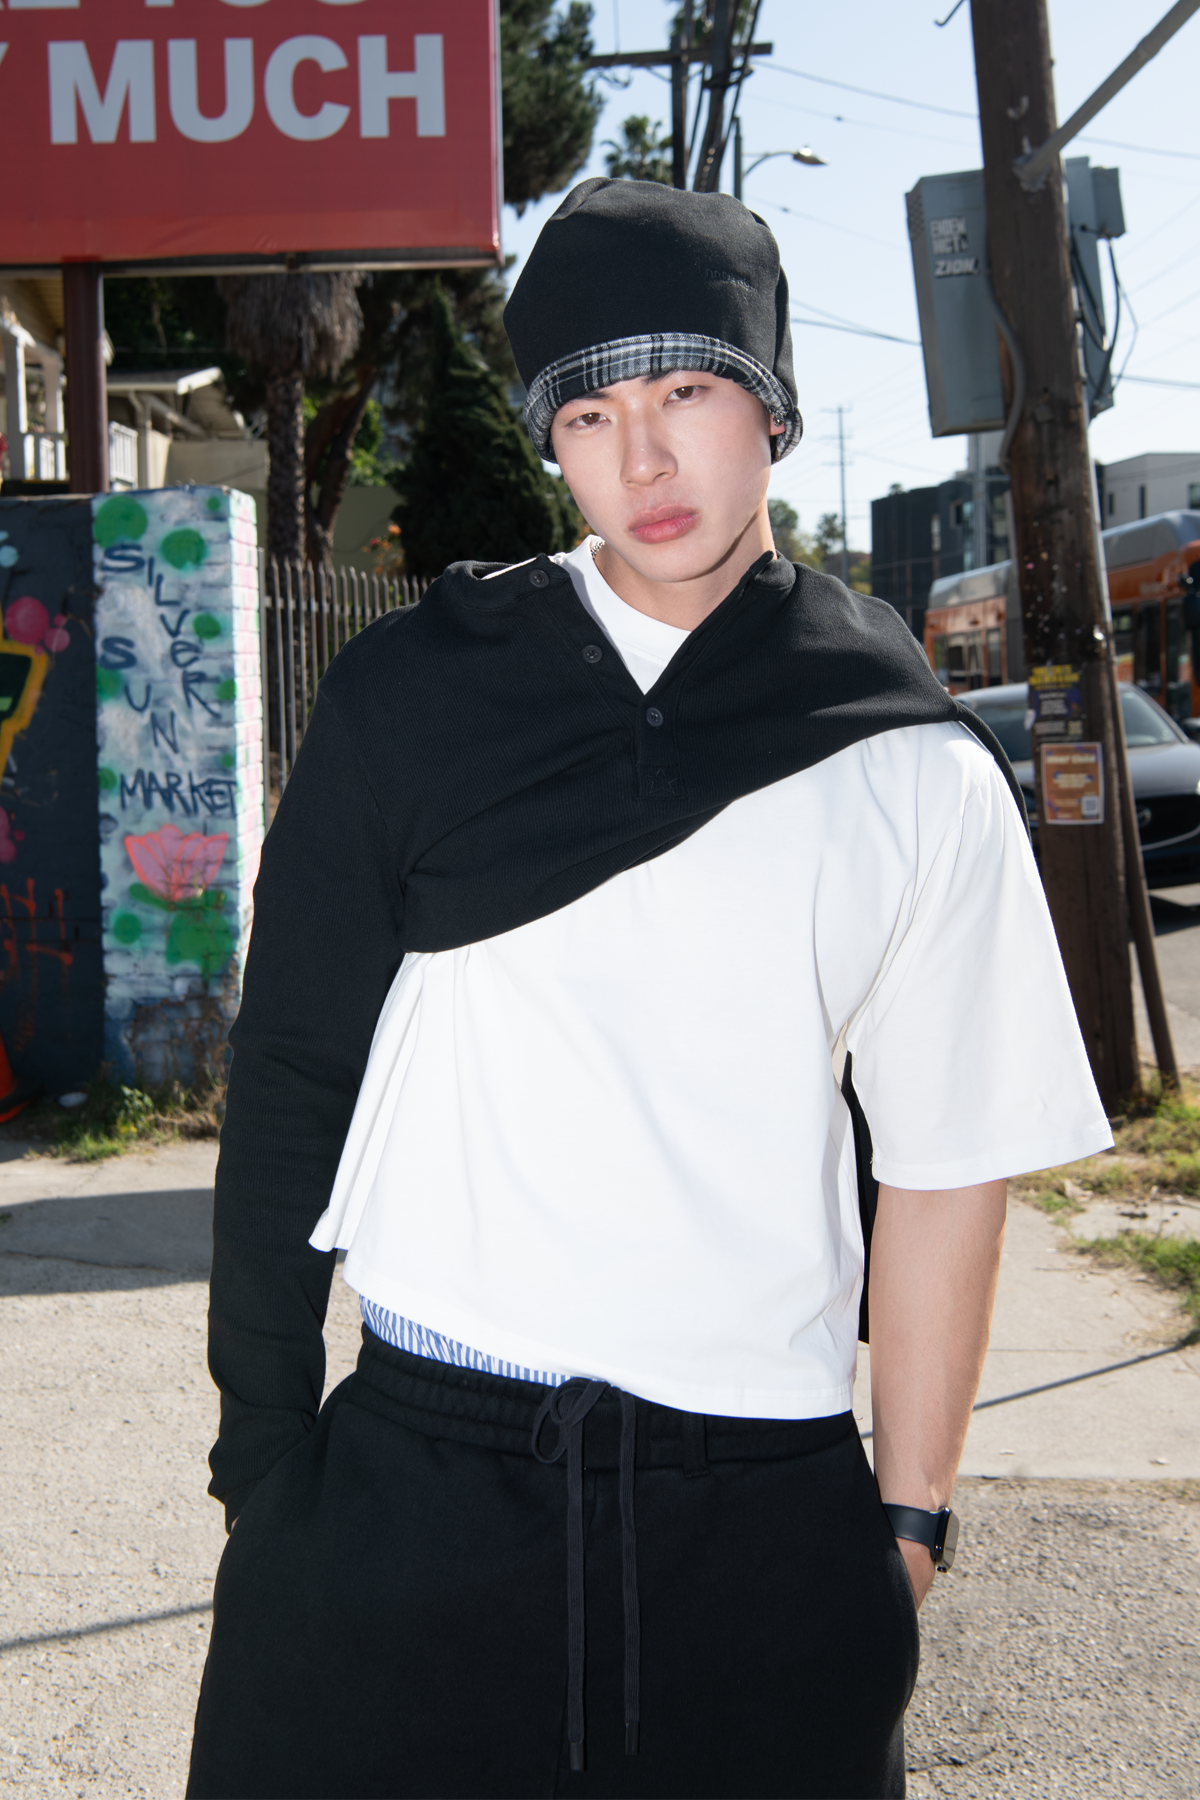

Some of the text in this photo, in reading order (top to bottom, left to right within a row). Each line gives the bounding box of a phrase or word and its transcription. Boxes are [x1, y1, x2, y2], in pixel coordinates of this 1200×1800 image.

[48, 34, 447, 145] MUCH
[99, 636, 180, 755] SUN
[119, 767, 238, 816] MARKET
